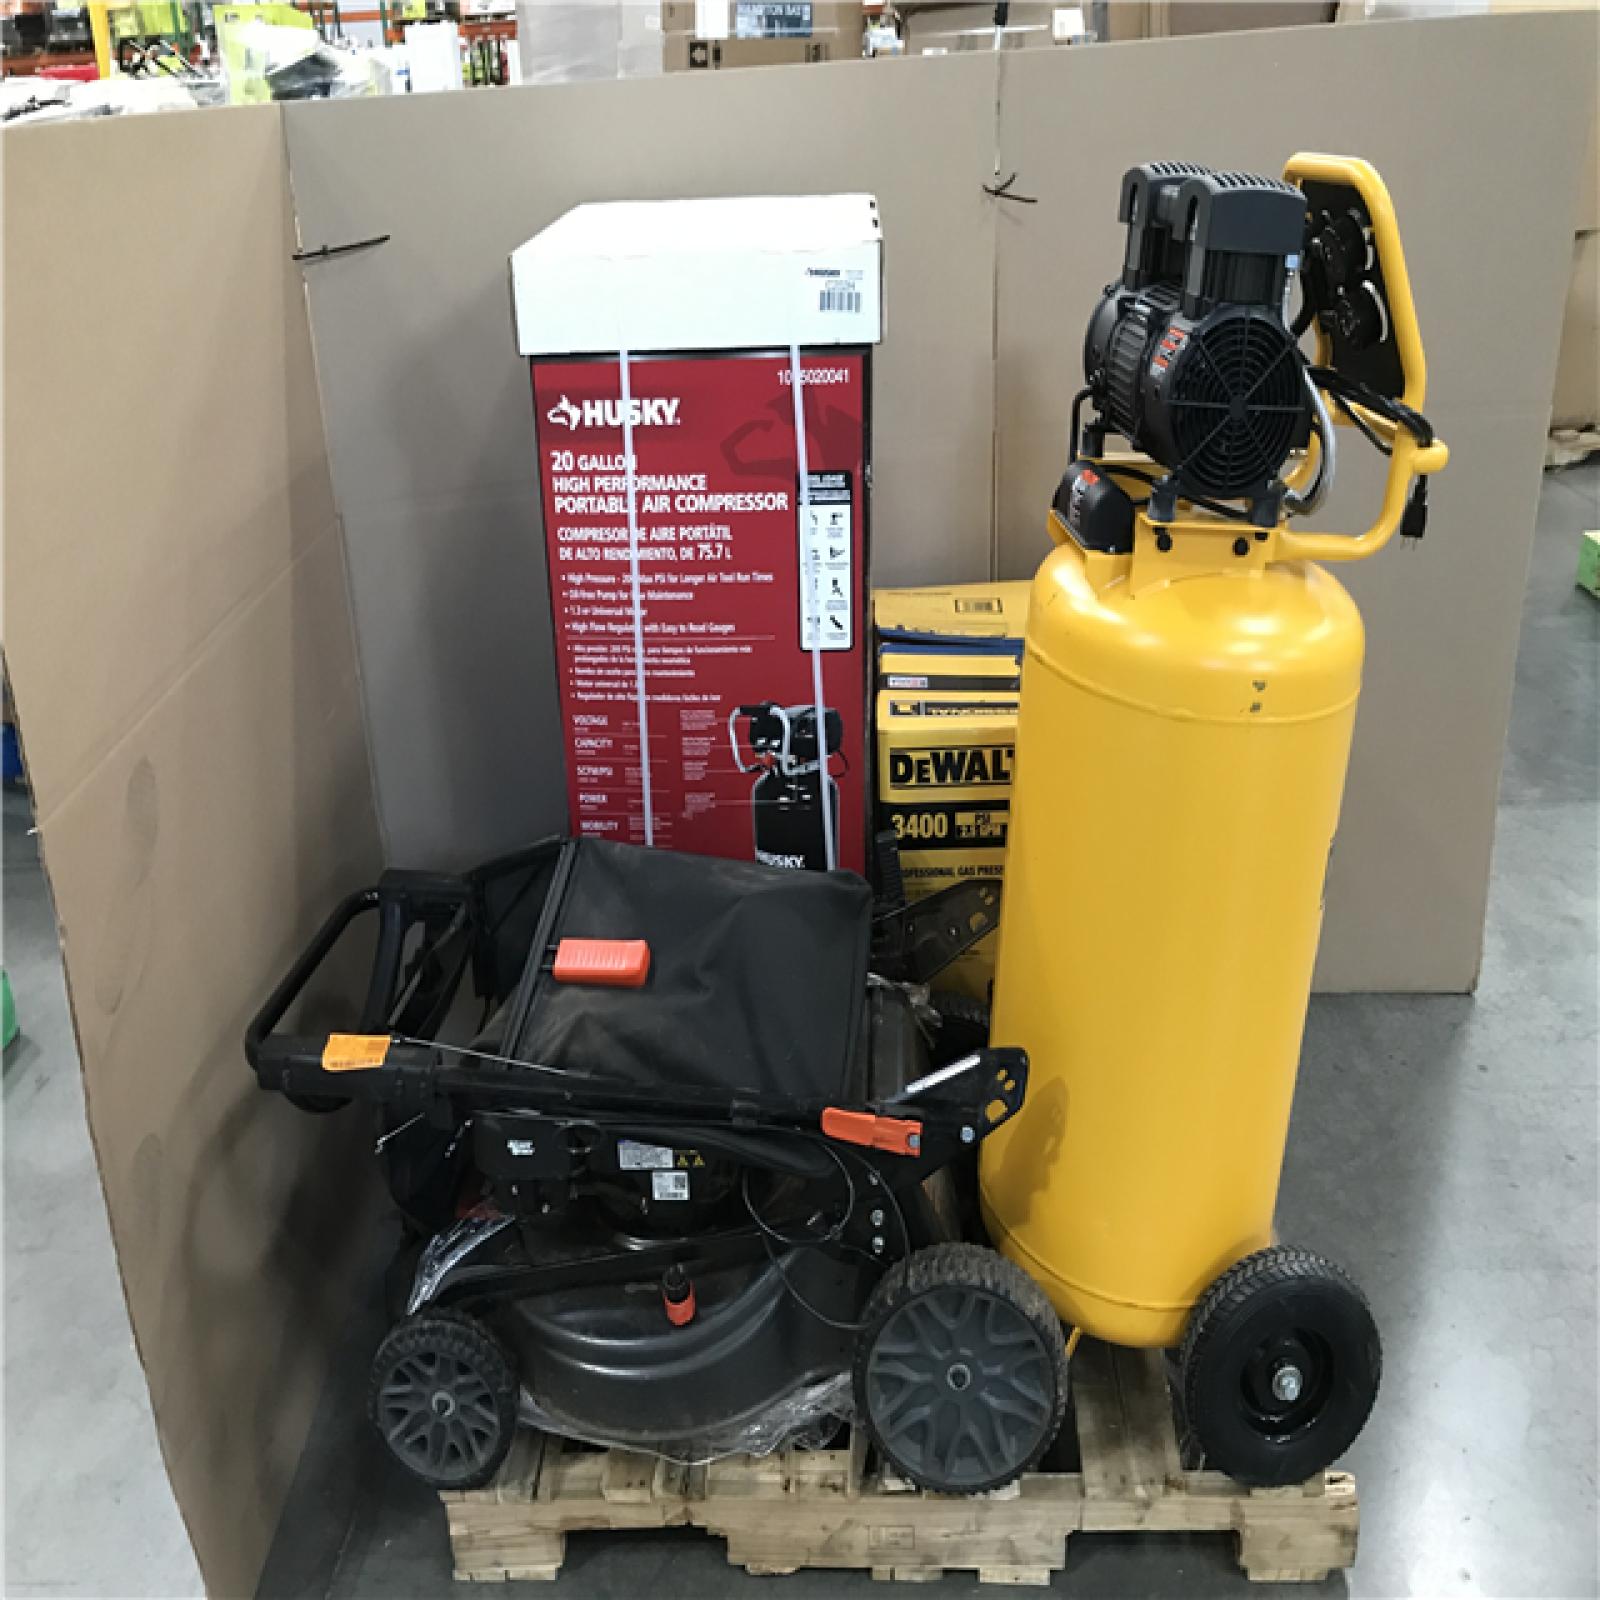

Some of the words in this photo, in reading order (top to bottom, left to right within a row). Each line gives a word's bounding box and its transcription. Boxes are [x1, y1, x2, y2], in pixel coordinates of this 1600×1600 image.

[777, 368, 849, 385] 105020041
[583, 398, 678, 426] HUSKY
[550, 450, 574, 472] 20
[552, 477, 590, 492] HIGH
[555, 495, 637, 513] PORTABL
[642, 494, 671, 513] AIR
[675, 493, 788, 512] COMPRESSOR
[650, 526, 676, 541] AIRE
[559, 547, 573, 560] DE
[575, 547, 601, 560] ALTO
[604, 547, 677, 562] RENDMIENTO,
[698, 543, 723, 560] 75.7
[892, 812, 948, 838] 3400
